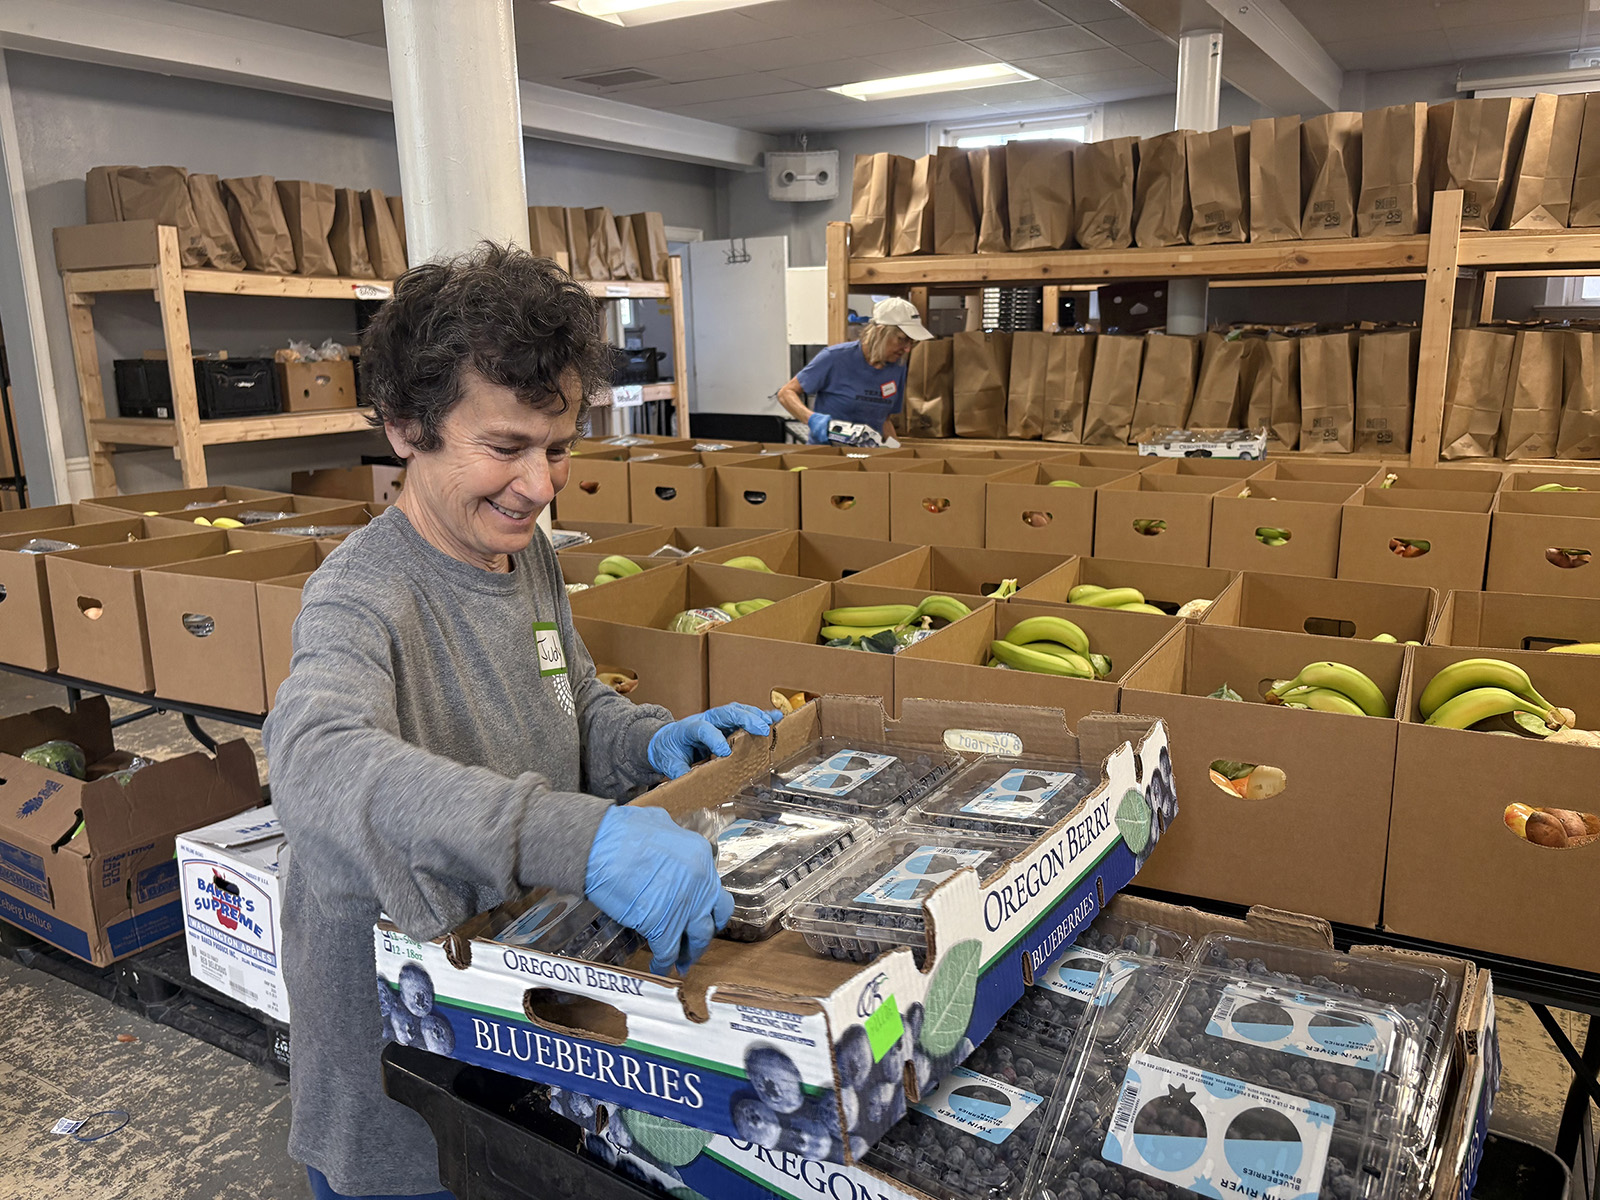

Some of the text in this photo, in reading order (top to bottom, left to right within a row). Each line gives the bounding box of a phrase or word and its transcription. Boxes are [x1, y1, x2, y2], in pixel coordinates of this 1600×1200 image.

[983, 797, 1113, 932] OREGON BERRY
[197, 878, 255, 912] BAKER'S
[23, 907, 53, 933] Lettuce
[194, 897, 263, 939] SUPREME
[188, 916, 238, 948] WASHINGTON
[240, 942, 272, 963] APPLES
[1031, 892, 1094, 972] BLUEBERRIES
[392, 944, 400, 955] 12
[406, 948, 424, 961] 18oz
[503, 949, 645, 997] OREGON BERRY
[1052, 981, 1078, 992] RIVER
[1305, 1044, 1370, 1062] TWIN RIVER
[1324, 1040, 1374, 1052] BLUEBERRIES
[474, 1018, 705, 1109] BLUEBERRIES
[938, 1108, 992, 1134] TWIN RIVER
[958, 1108, 1000, 1126] BLUEBERRIES
[1220, 1178, 1259, 1198] RIVER
[1242, 1167, 1300, 1191] BLUEBERRIES
[1271, 1170, 1302, 1184] Bleuets
